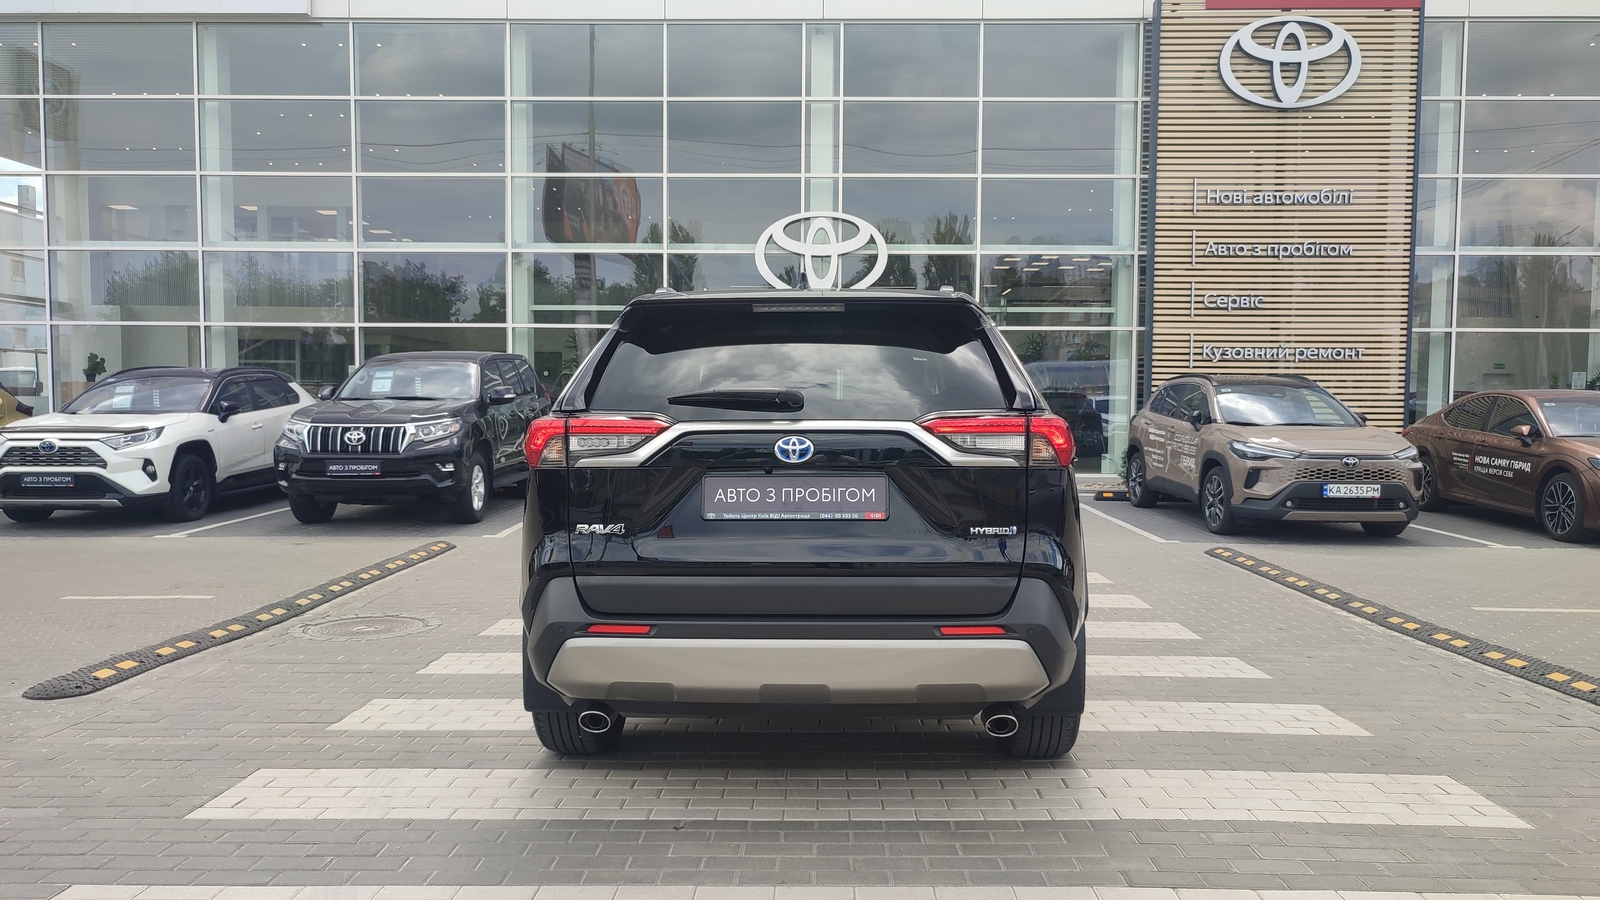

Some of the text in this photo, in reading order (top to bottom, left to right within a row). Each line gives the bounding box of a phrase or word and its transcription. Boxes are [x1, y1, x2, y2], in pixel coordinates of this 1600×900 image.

[1206, 189, 1354, 205] Нові автомобілі
[1204, 241, 1353, 260] Авто з пробігом
[1203, 293, 1265, 311] Сервіс
[1202, 343, 1365, 362] Кузовний ремонт
[1166, 441, 1197, 455] CROSS
[1475, 455, 1490, 465] НОВА
[1491, 457, 1510, 468] CAMRY
[1510, 460, 1531, 473] ГІБРИД
[714, 488, 876, 502] АВТО З ПРОБІГОМ
[1328, 486, 1342, 495] KA
[1344, 486, 1365, 495] 2635
[575, 523, 625, 535] RAV4
[970, 527, 1010, 535] HYBRID
